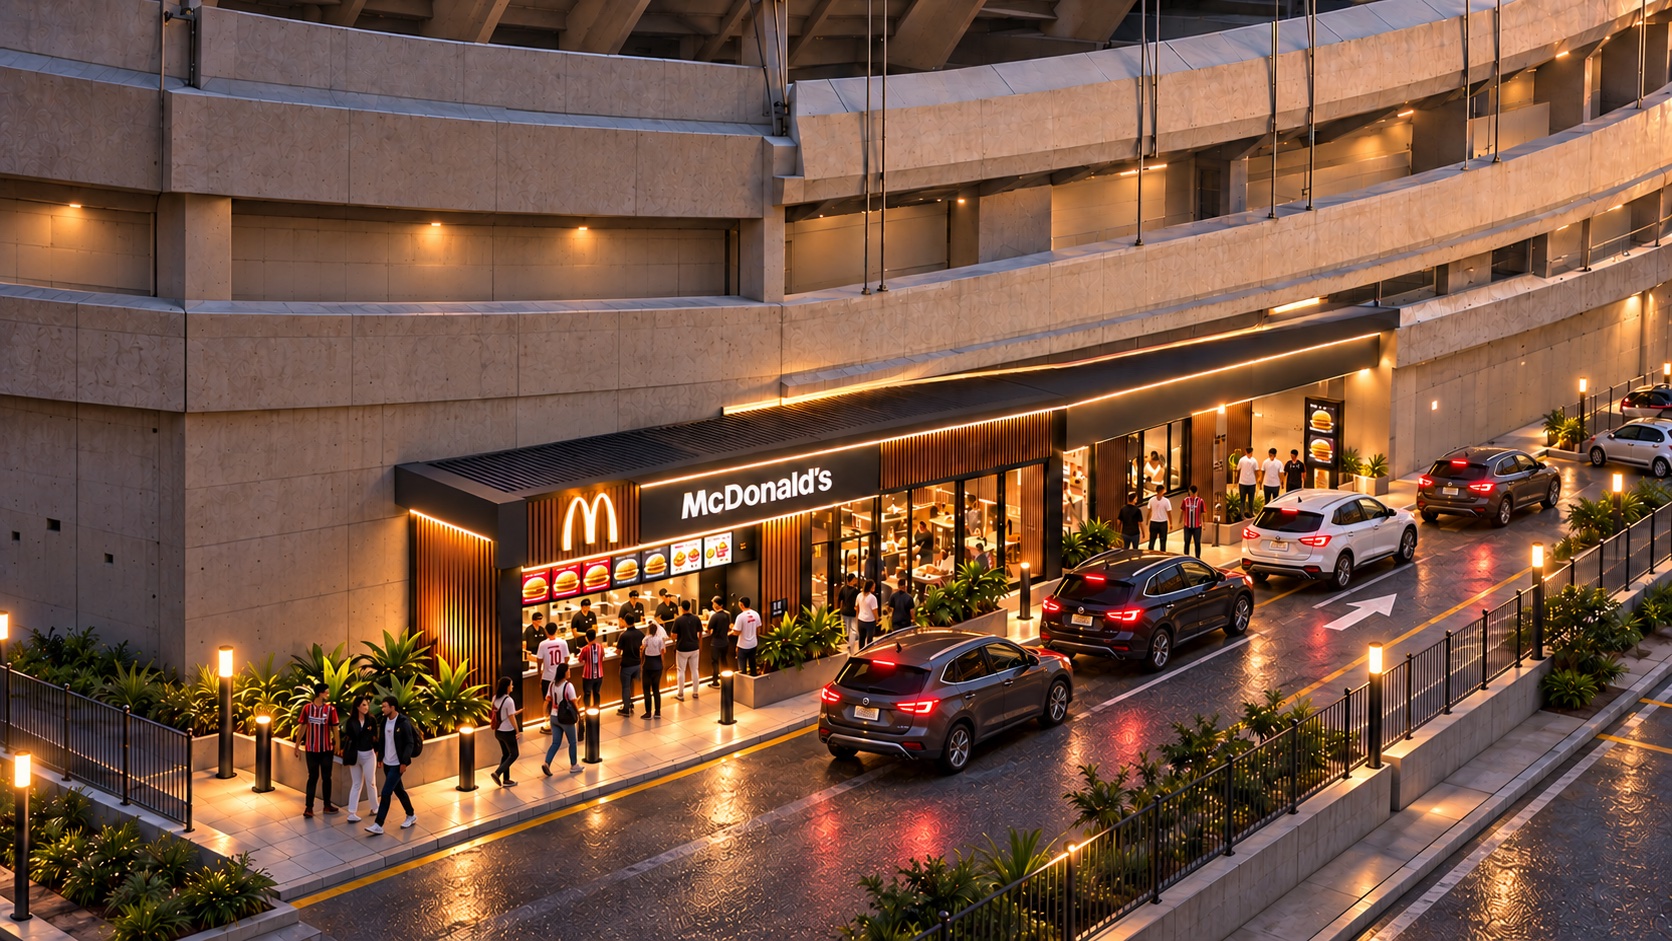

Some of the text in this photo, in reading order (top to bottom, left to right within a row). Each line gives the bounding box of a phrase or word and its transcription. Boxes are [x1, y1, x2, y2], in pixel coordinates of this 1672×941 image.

[681, 467, 833, 520] McDonald's
[562, 493, 618, 551] M
[549, 650, 561, 666] 10
